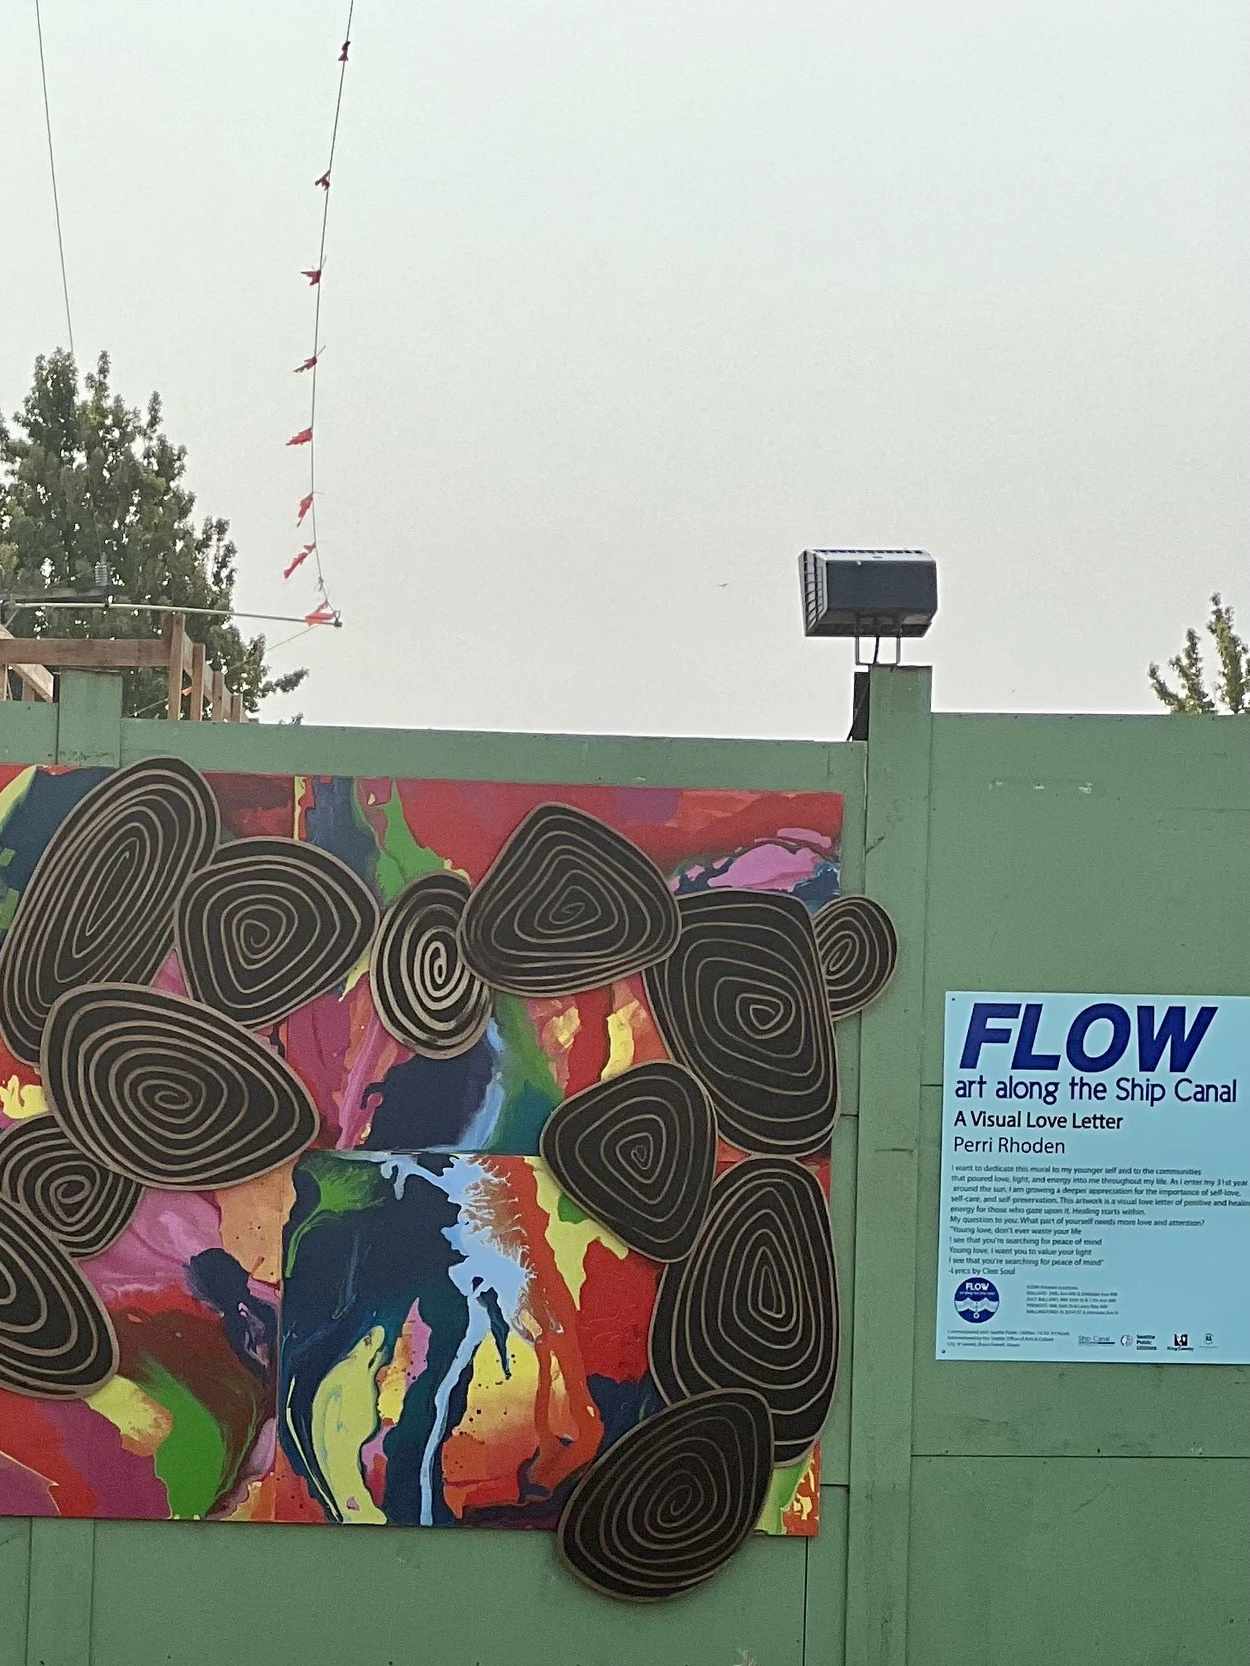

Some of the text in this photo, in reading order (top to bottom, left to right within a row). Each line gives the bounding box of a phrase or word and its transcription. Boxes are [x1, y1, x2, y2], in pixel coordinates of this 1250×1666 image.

[959, 1002, 1219, 1073] FLOW
[955, 1075, 1237, 1107] art along the Ship Canal
[954, 1111, 1123, 1130] A Visual Love Letter
[954, 1137, 1065, 1154] Perri Rhoden
[967, 1175, 993, 1183] poured
[1101, 1177, 1142, 1186] throughout
[1025, 1186, 1055, 1194] growing
[1062, 1187, 1088, 1195] deeper
[1088, 1187, 1133, 1196] appreciation
[1158, 1188, 1200, 1197] importance
[1184, 1199, 1212, 1207] positive
[1072, 1207, 1100, 1216] Healing
[950, 1216, 962, 1224] My
[962, 1216, 994, 1224] question
[1040, 1217, 1055, 1225] part
[1065, 1218, 1094, 1226] yourself
[982, 1237, 1004, 1245] you're
[1005, 1237, 1040, 1245] searching
[950, 1246, 972, 1255] Young
[1075, 1248, 1092, 1257] light
[981, 1257, 1004, 1265] you're
[1004, 1258, 1039, 1266] searching
[971, 1267, 981, 1275] by
[965, 1282, 990, 1291] FLOW
